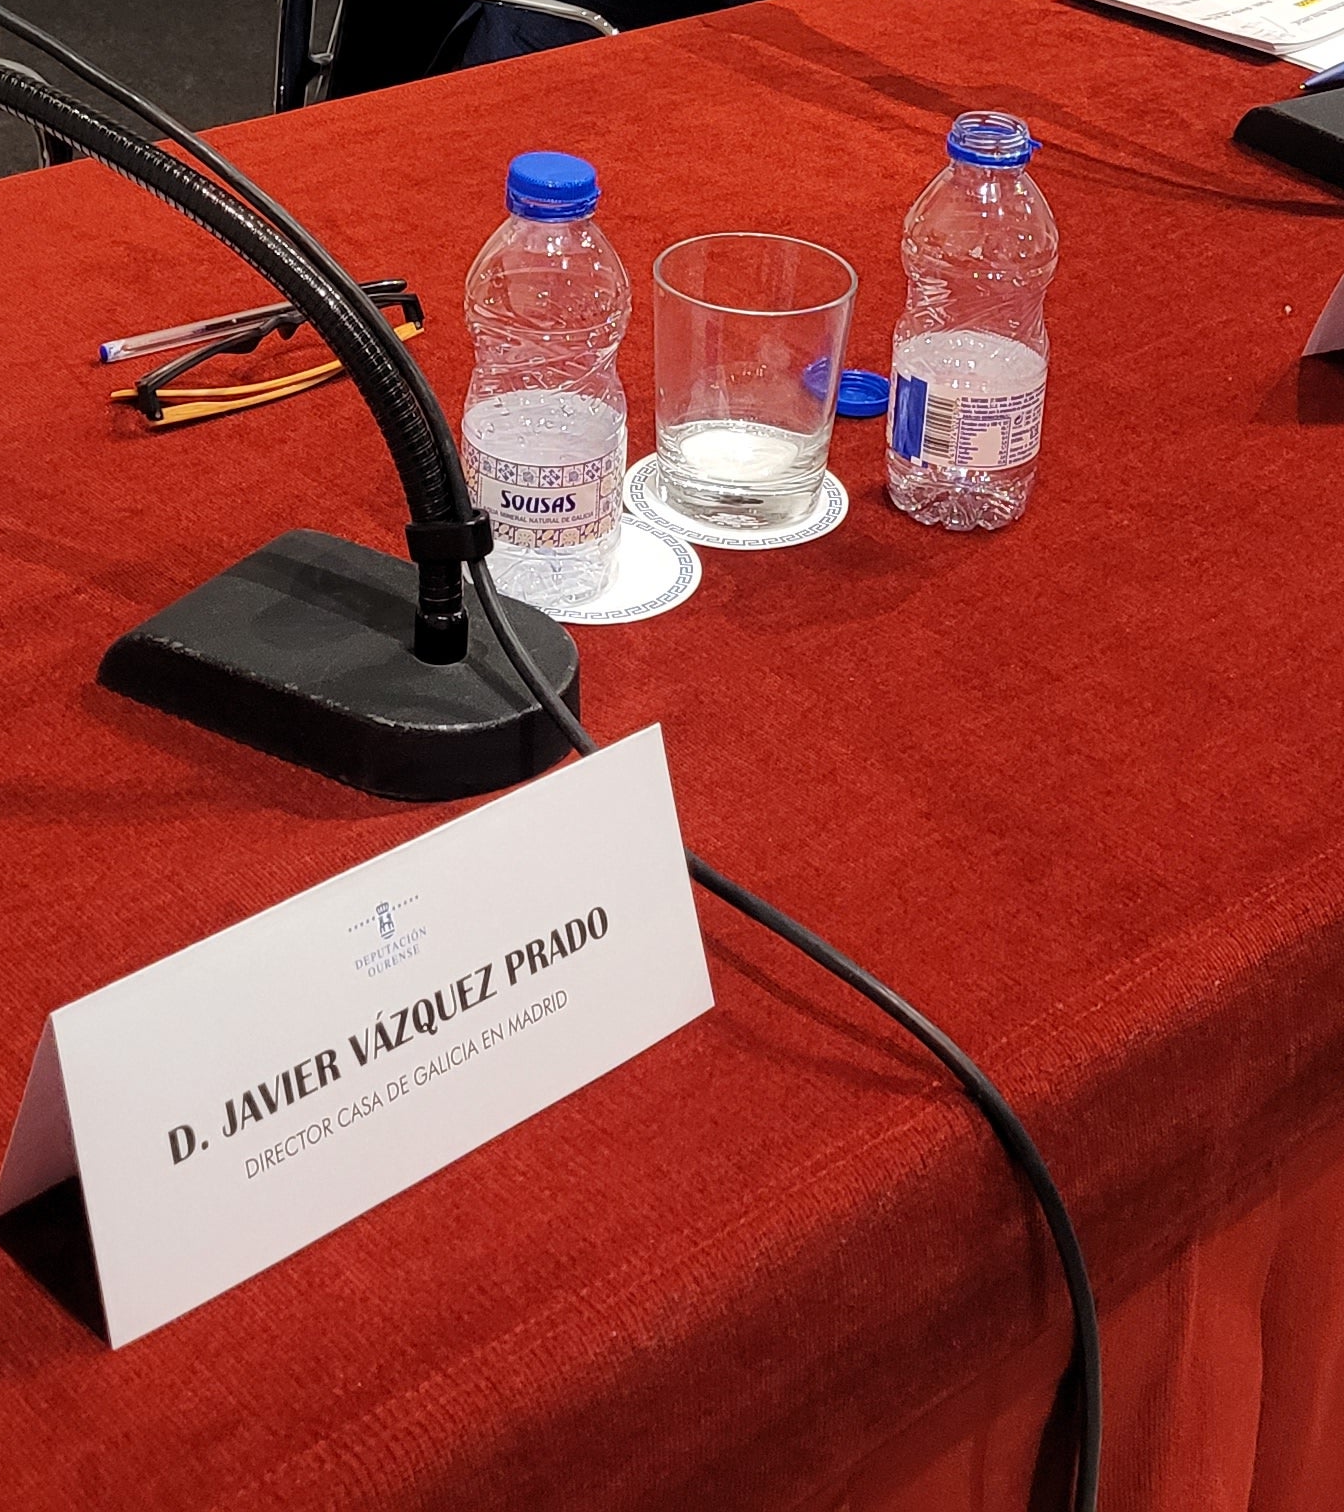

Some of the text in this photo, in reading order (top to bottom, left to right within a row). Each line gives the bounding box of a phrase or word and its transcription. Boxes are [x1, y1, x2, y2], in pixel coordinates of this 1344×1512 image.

[500, 490, 577, 514] SOUSAS
[528, 516, 560, 524] NATURAL
[571, 511, 594, 522] GALICIA
[355, 925, 427, 970] DEPUTACIÓN
[367, 943, 420, 978] OURENSE
[167, 906, 609, 1166] D. JAVIER VÁZQUEZ PRADO
[244, 989, 569, 1180] DIRECTOR CASA DE GALICIA EN MADRID
